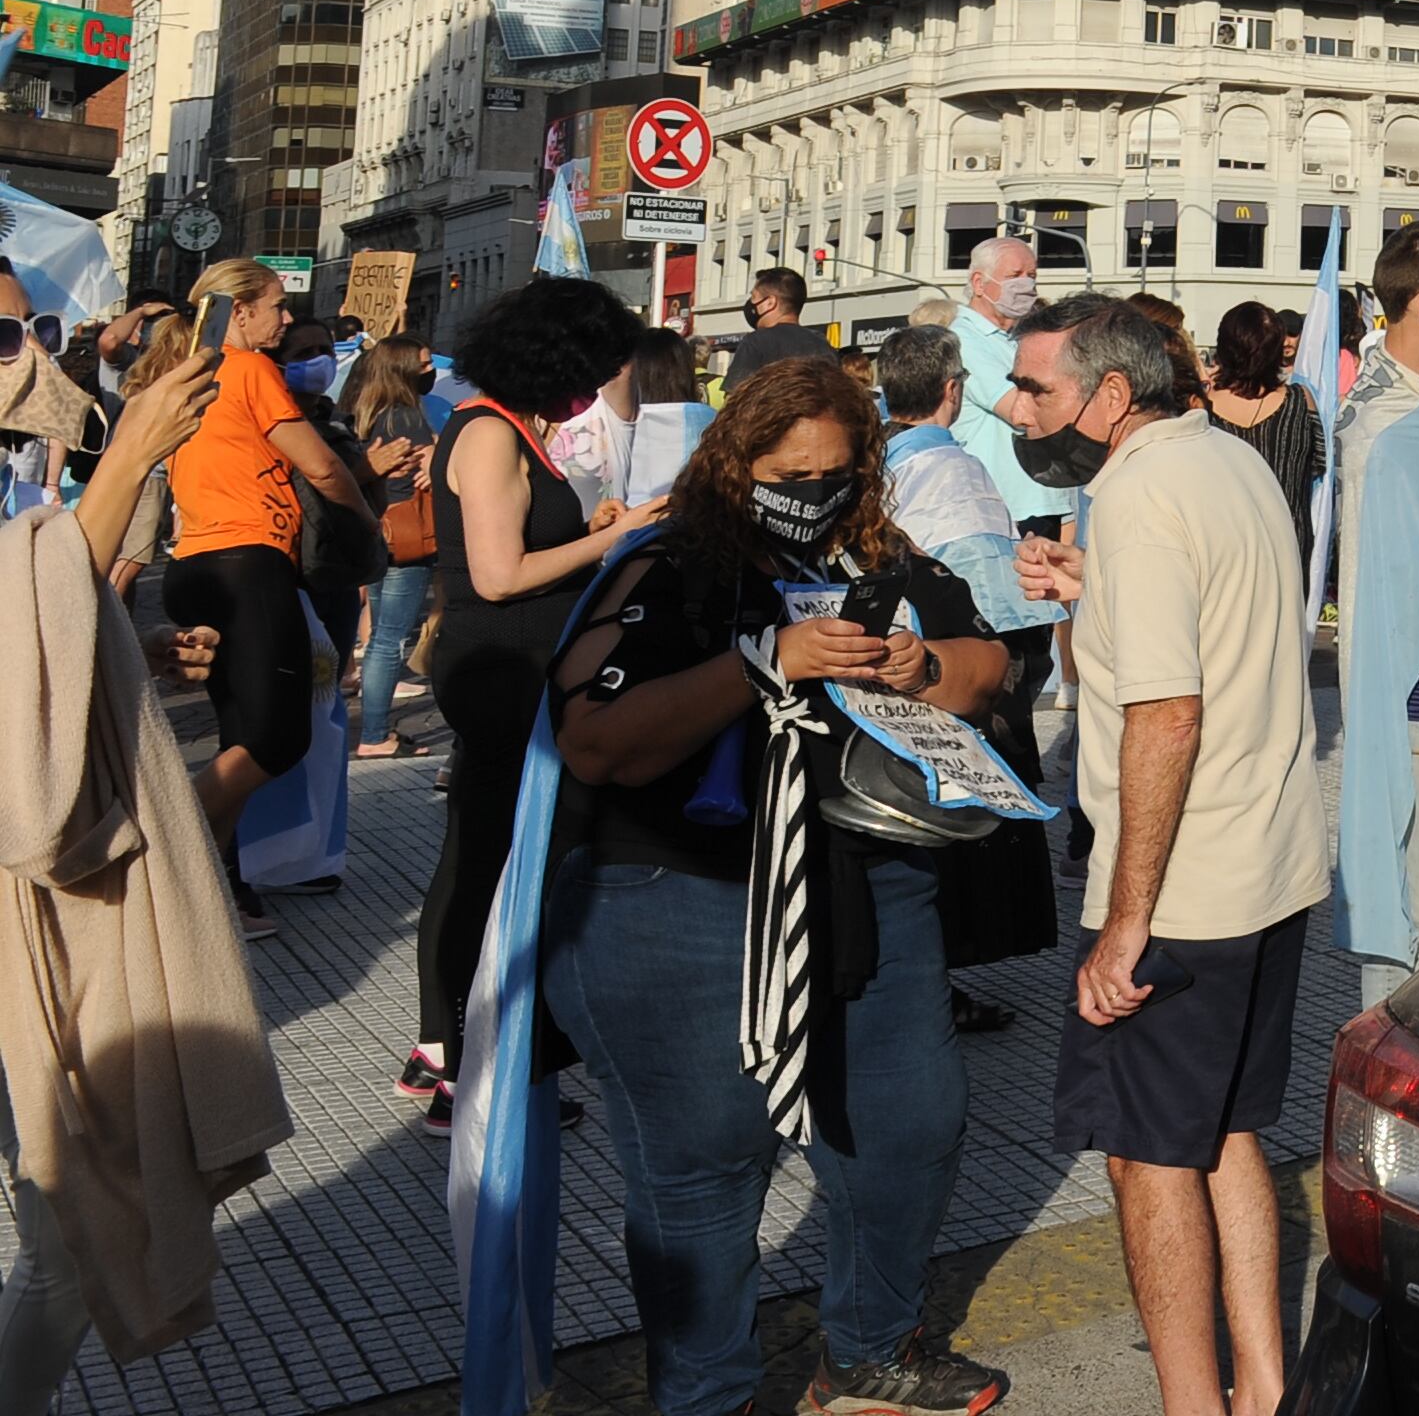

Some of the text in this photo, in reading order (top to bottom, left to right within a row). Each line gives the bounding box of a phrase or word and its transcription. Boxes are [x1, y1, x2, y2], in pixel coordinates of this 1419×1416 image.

[629, 196, 704, 211] NO ESTACIONAR
[645, 210, 699, 222] DETENERSE
[640, 224, 661, 234] Sobre
[354, 292, 373, 315] NO
[752, 484, 791, 514] ARRANCO
[790, 499, 802, 517] EL
[767, 516, 794, 539] TODOS
[794, 525, 801, 541] A
[801, 527, 814, 543] LA
